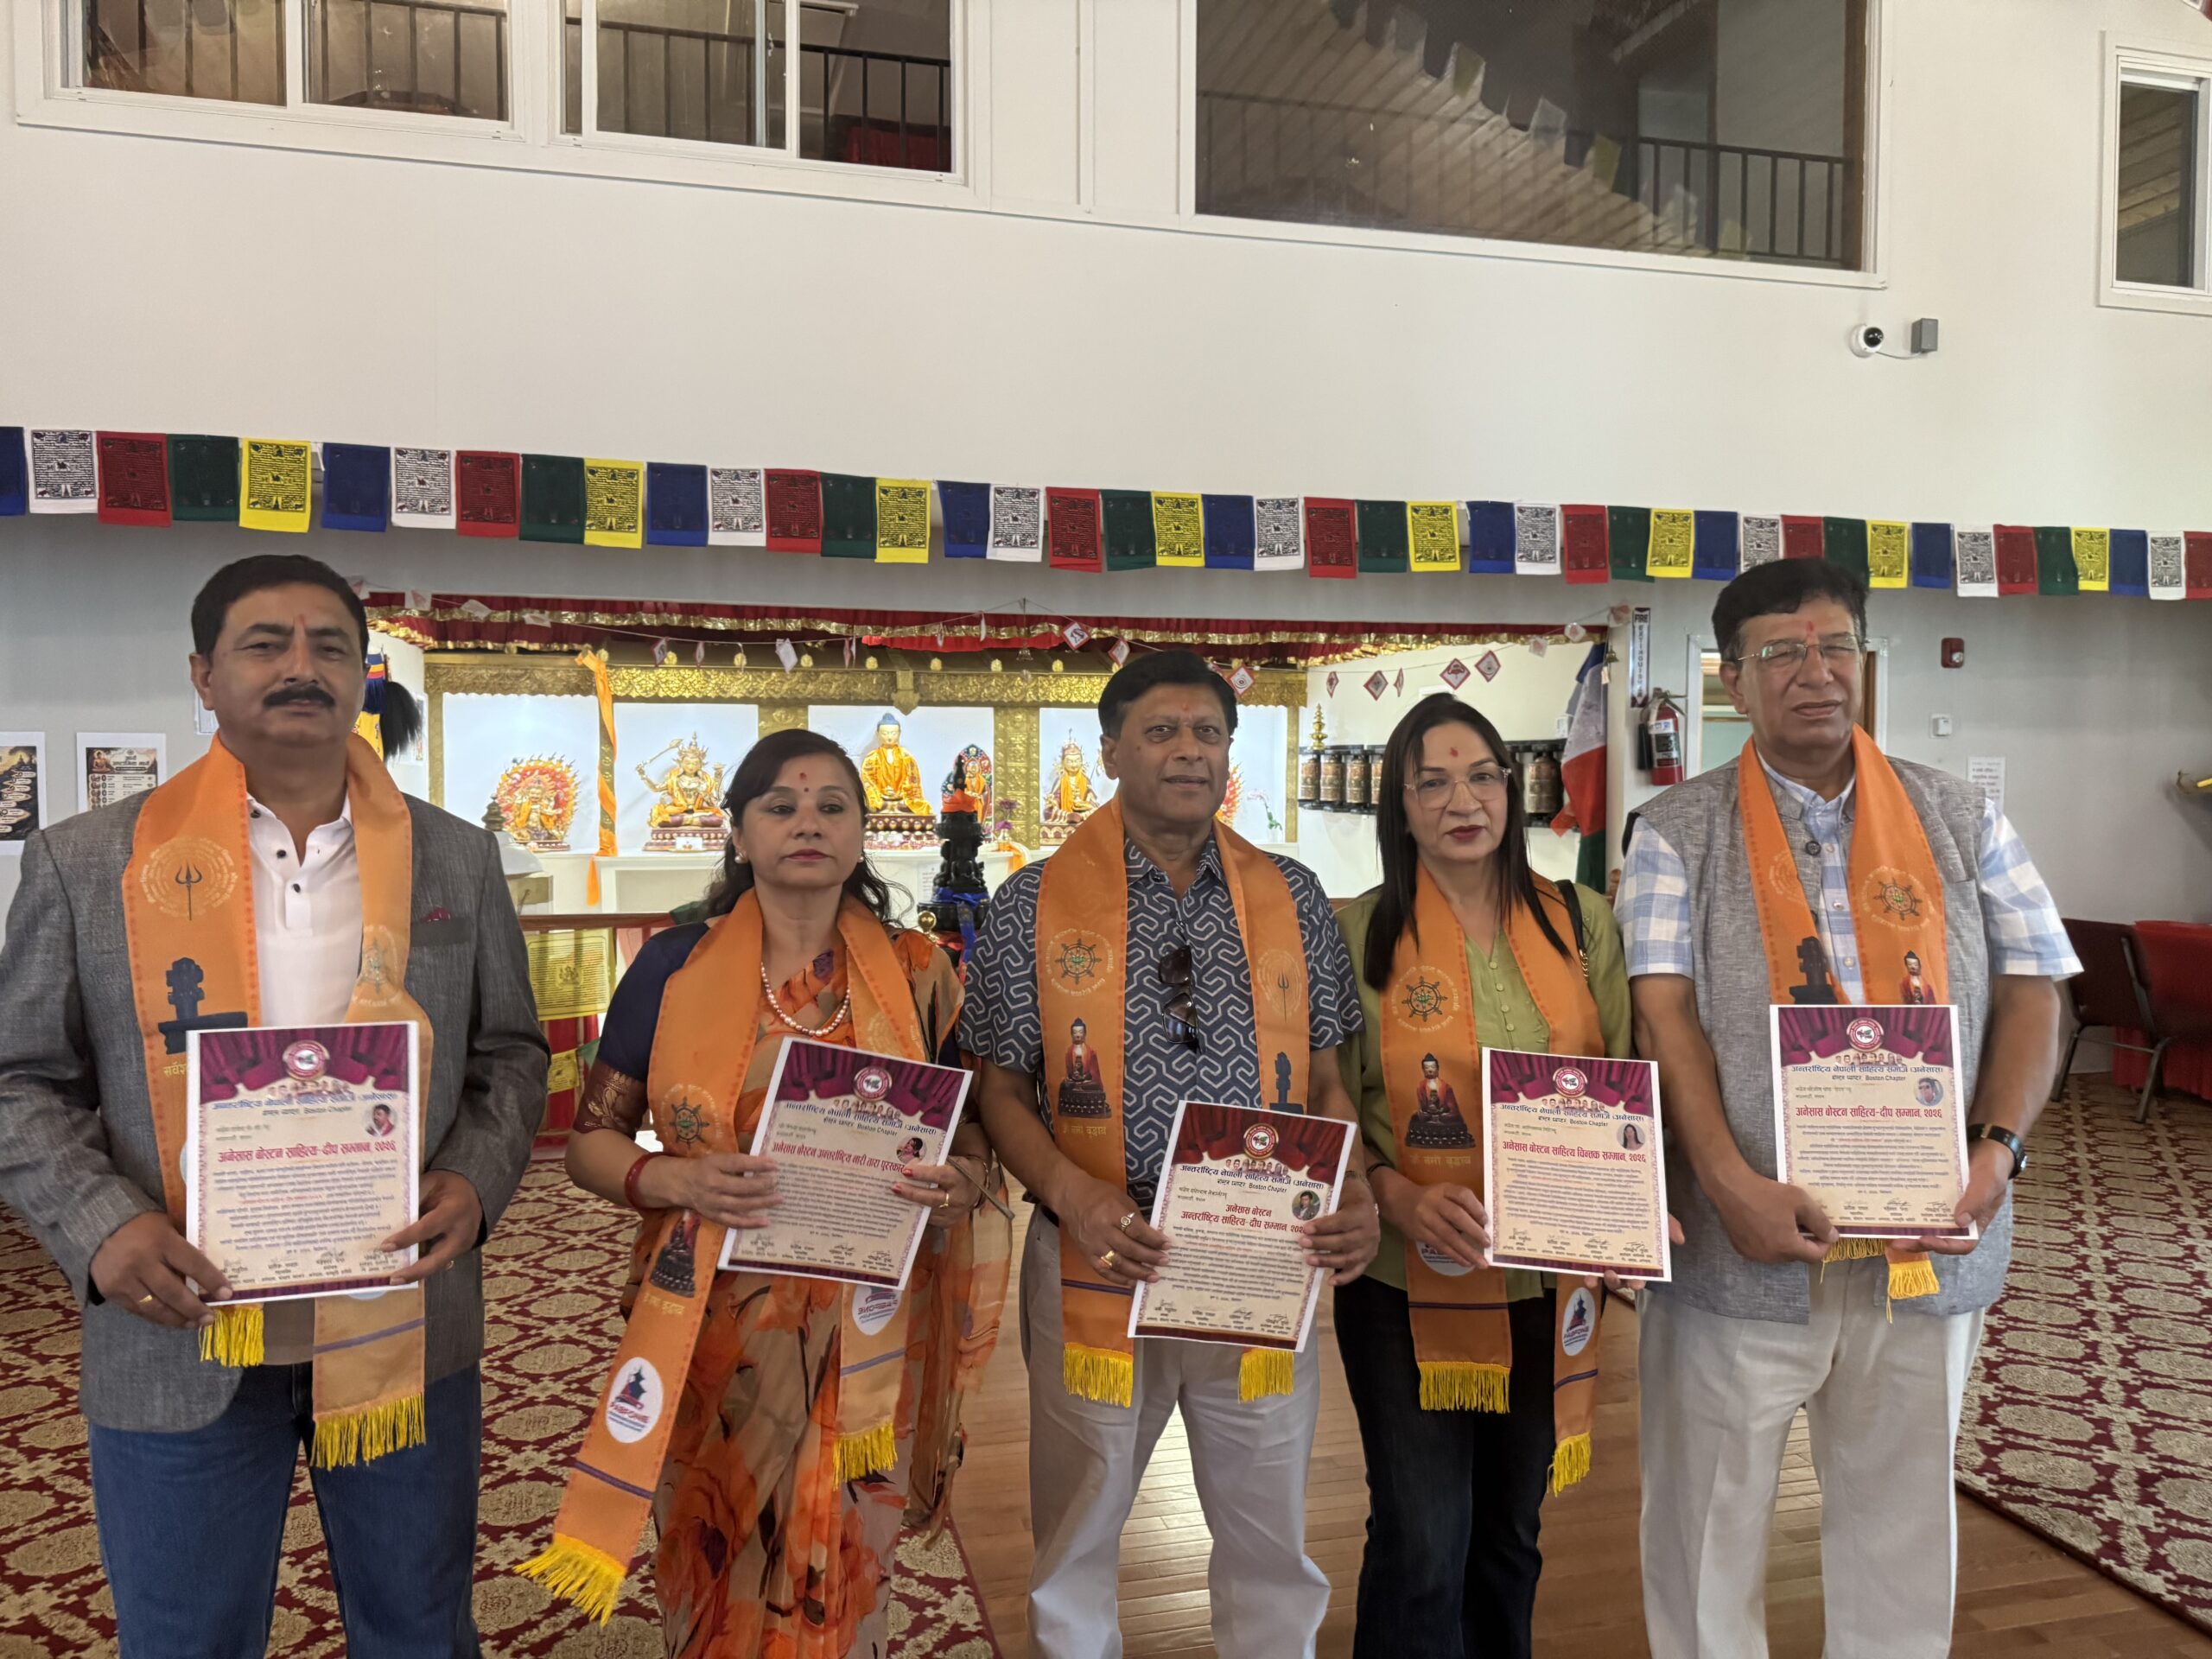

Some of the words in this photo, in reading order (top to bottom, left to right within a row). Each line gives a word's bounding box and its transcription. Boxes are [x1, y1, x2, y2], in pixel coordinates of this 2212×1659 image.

[1634, 613, 1649, 623] FIRE
[1796, 1104, 1823, 1117] अनेसास
[1825, 1105, 1847, 1117] बोस्टन
[1923, 1109, 1942, 1118] २०२६
[857, 1123, 876, 1133] Boston
[877, 1127, 898, 1136] Chapter
[772, 1141, 796, 1154] अनेसास
[797, 1143, 816, 1157] बोस्टन
[853, 1154, 866, 1165] नारी
[867, 1158, 880, 1167] तारा
[1503, 1140, 1528, 1151] अनेसास
[1529, 1142, 1549, 1154] बोस्टन
[1552, 1145, 1575, 1157] साहित्य
[1577, 1147, 1600, 1159] चिन्तक
[1629, 1154, 1646, 1163] २०२६
[1220, 1167, 1243, 1179] नेपाली
[1244, 1171, 1269, 1182] साहित्य
[1271, 1175, 1292, 1185] समाज
[1249, 1182, 1267, 1191] Boston
[1268, 1185, 1287, 1193] Chapter
[1225, 1203, 1250, 1214] अनेसास
[1251, 1205, 1272, 1217] बोस्टन
[1264, 1221, 1287, 1231] सम्मान
[1290, 1224, 1306, 1234] २०२
